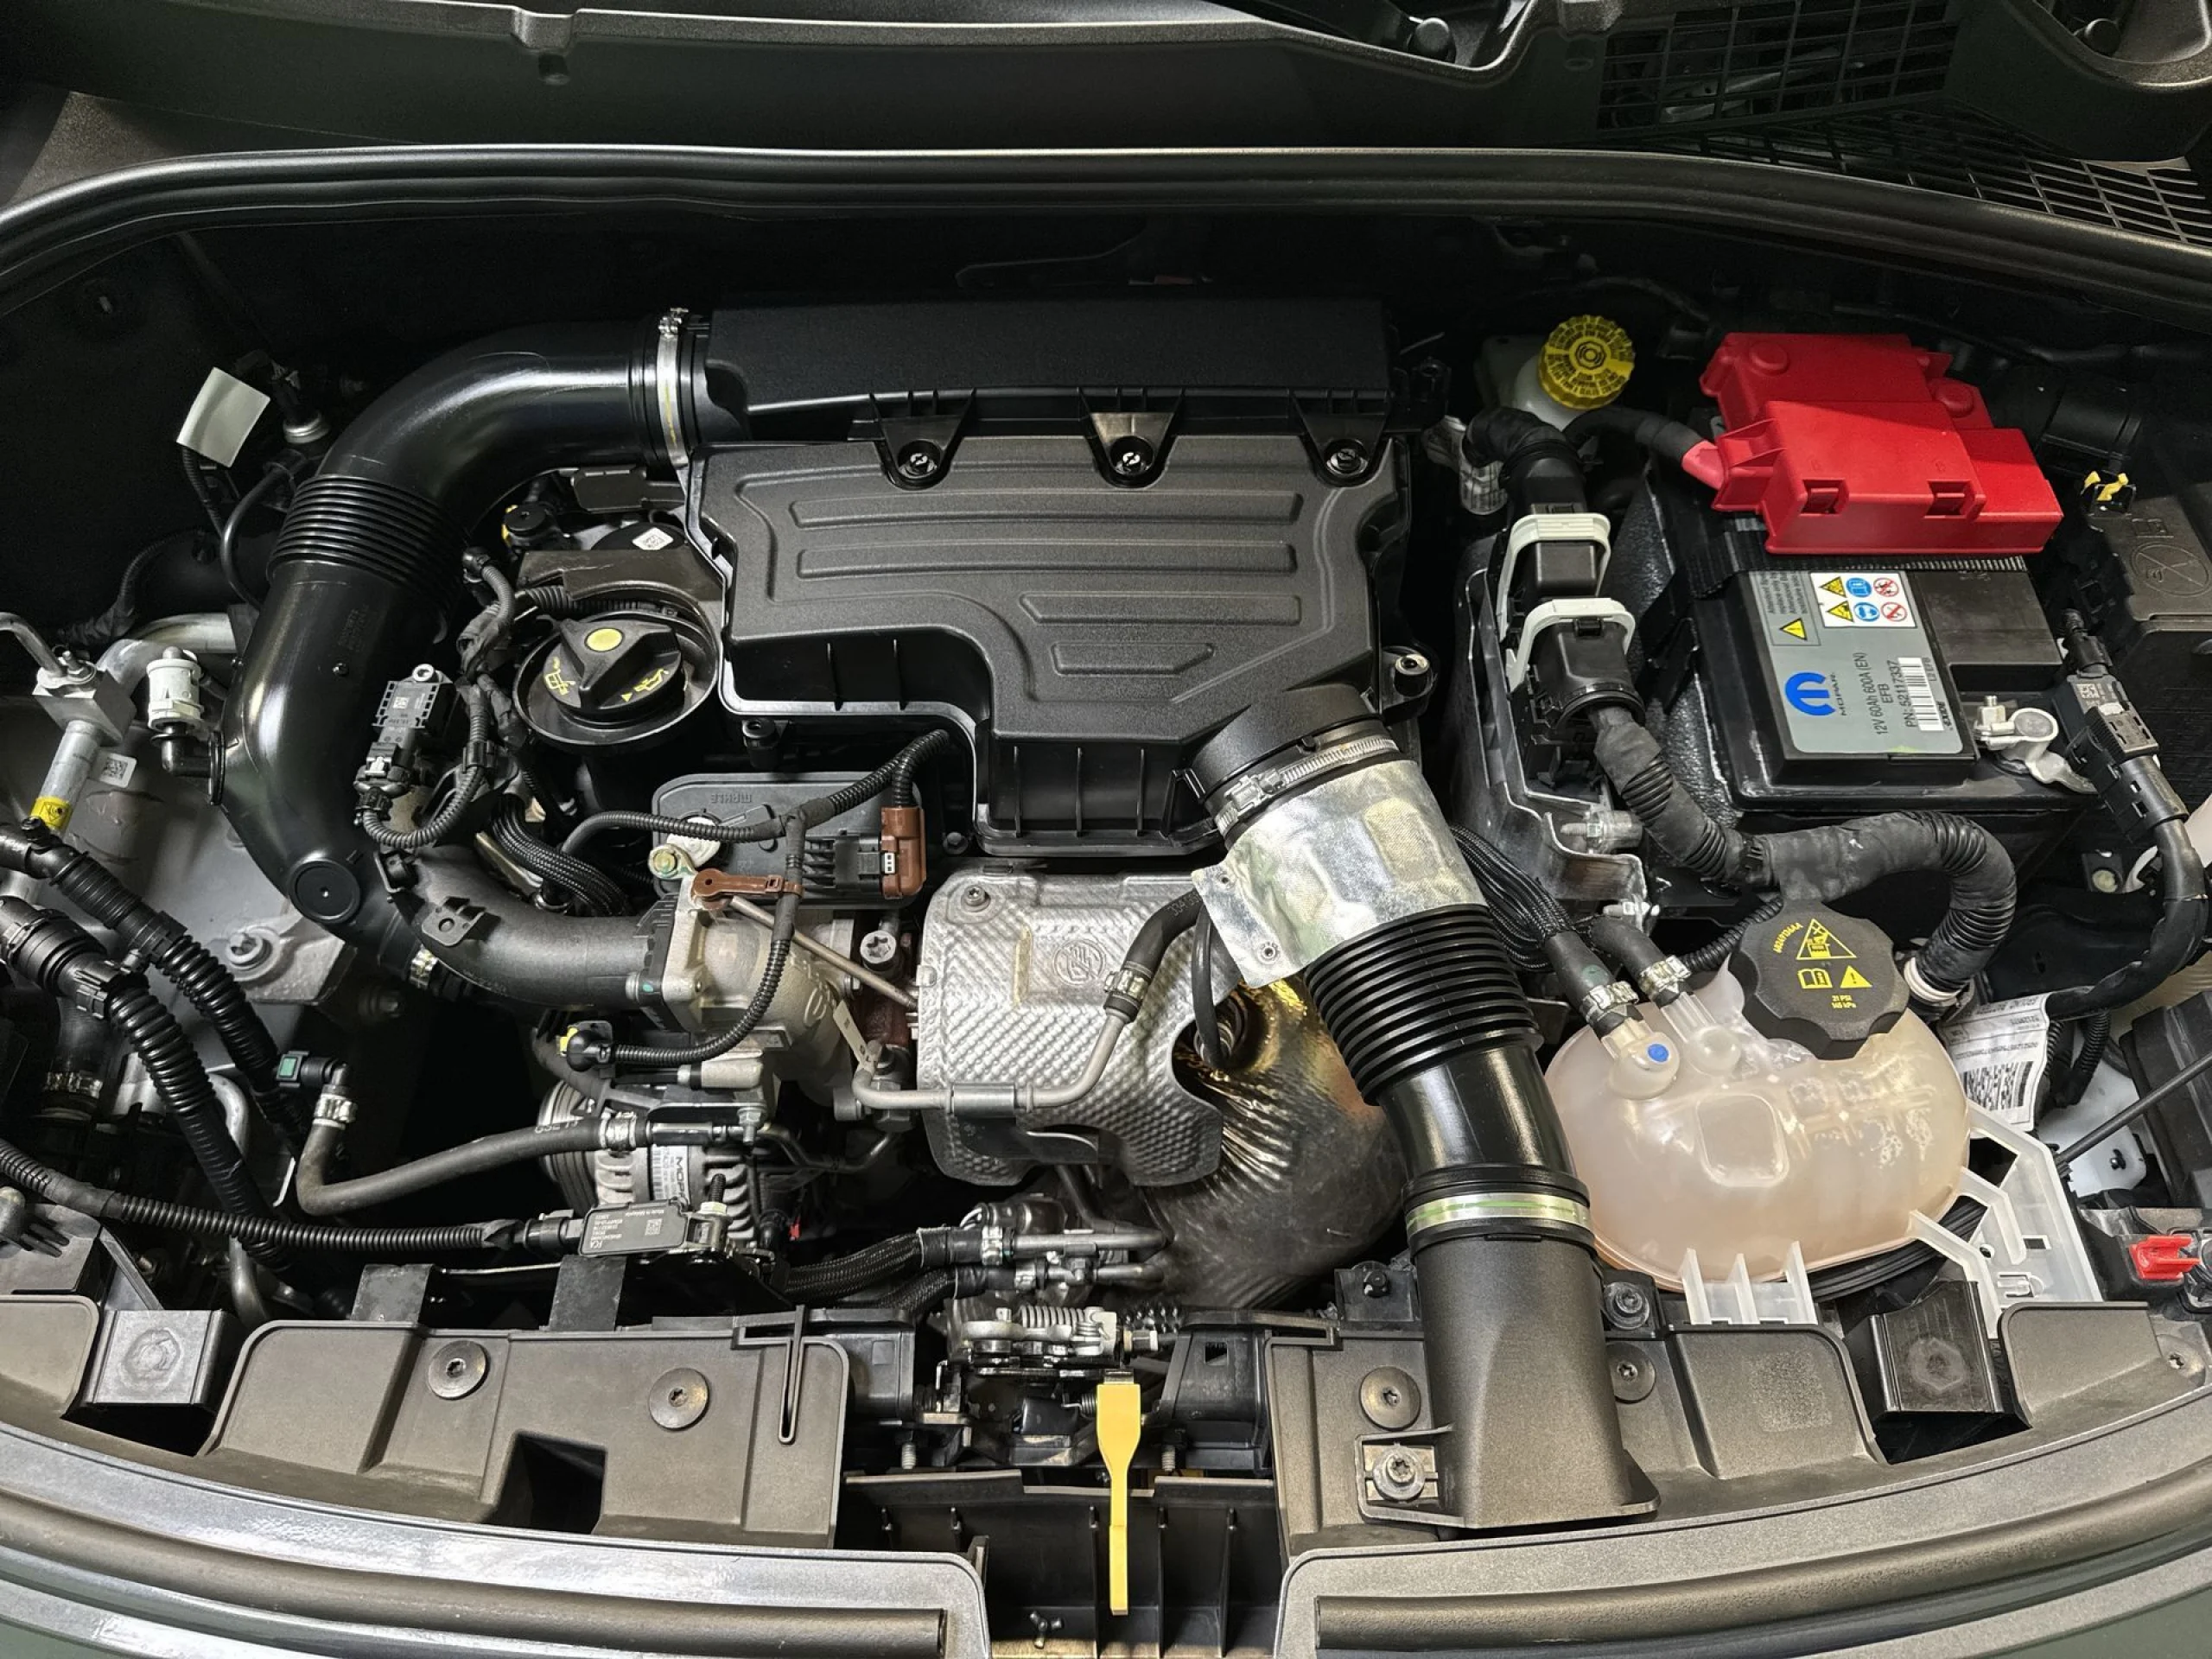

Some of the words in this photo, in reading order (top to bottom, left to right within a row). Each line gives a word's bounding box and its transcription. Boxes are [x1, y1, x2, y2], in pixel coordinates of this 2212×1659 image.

[1853, 652, 1870, 671] (EN)
[1922, 657, 1936, 673] EFB
[1861, 671, 1876, 694] 600A
[1887, 660, 1913, 707] 52117337
[1878, 683, 1894, 704] EFB
[1868, 695, 1884, 719] 60Ah
[1876, 719, 1889, 734] 12V
[1905, 709, 1917, 728] PN:
[676, 1156, 685, 1198] MOP
